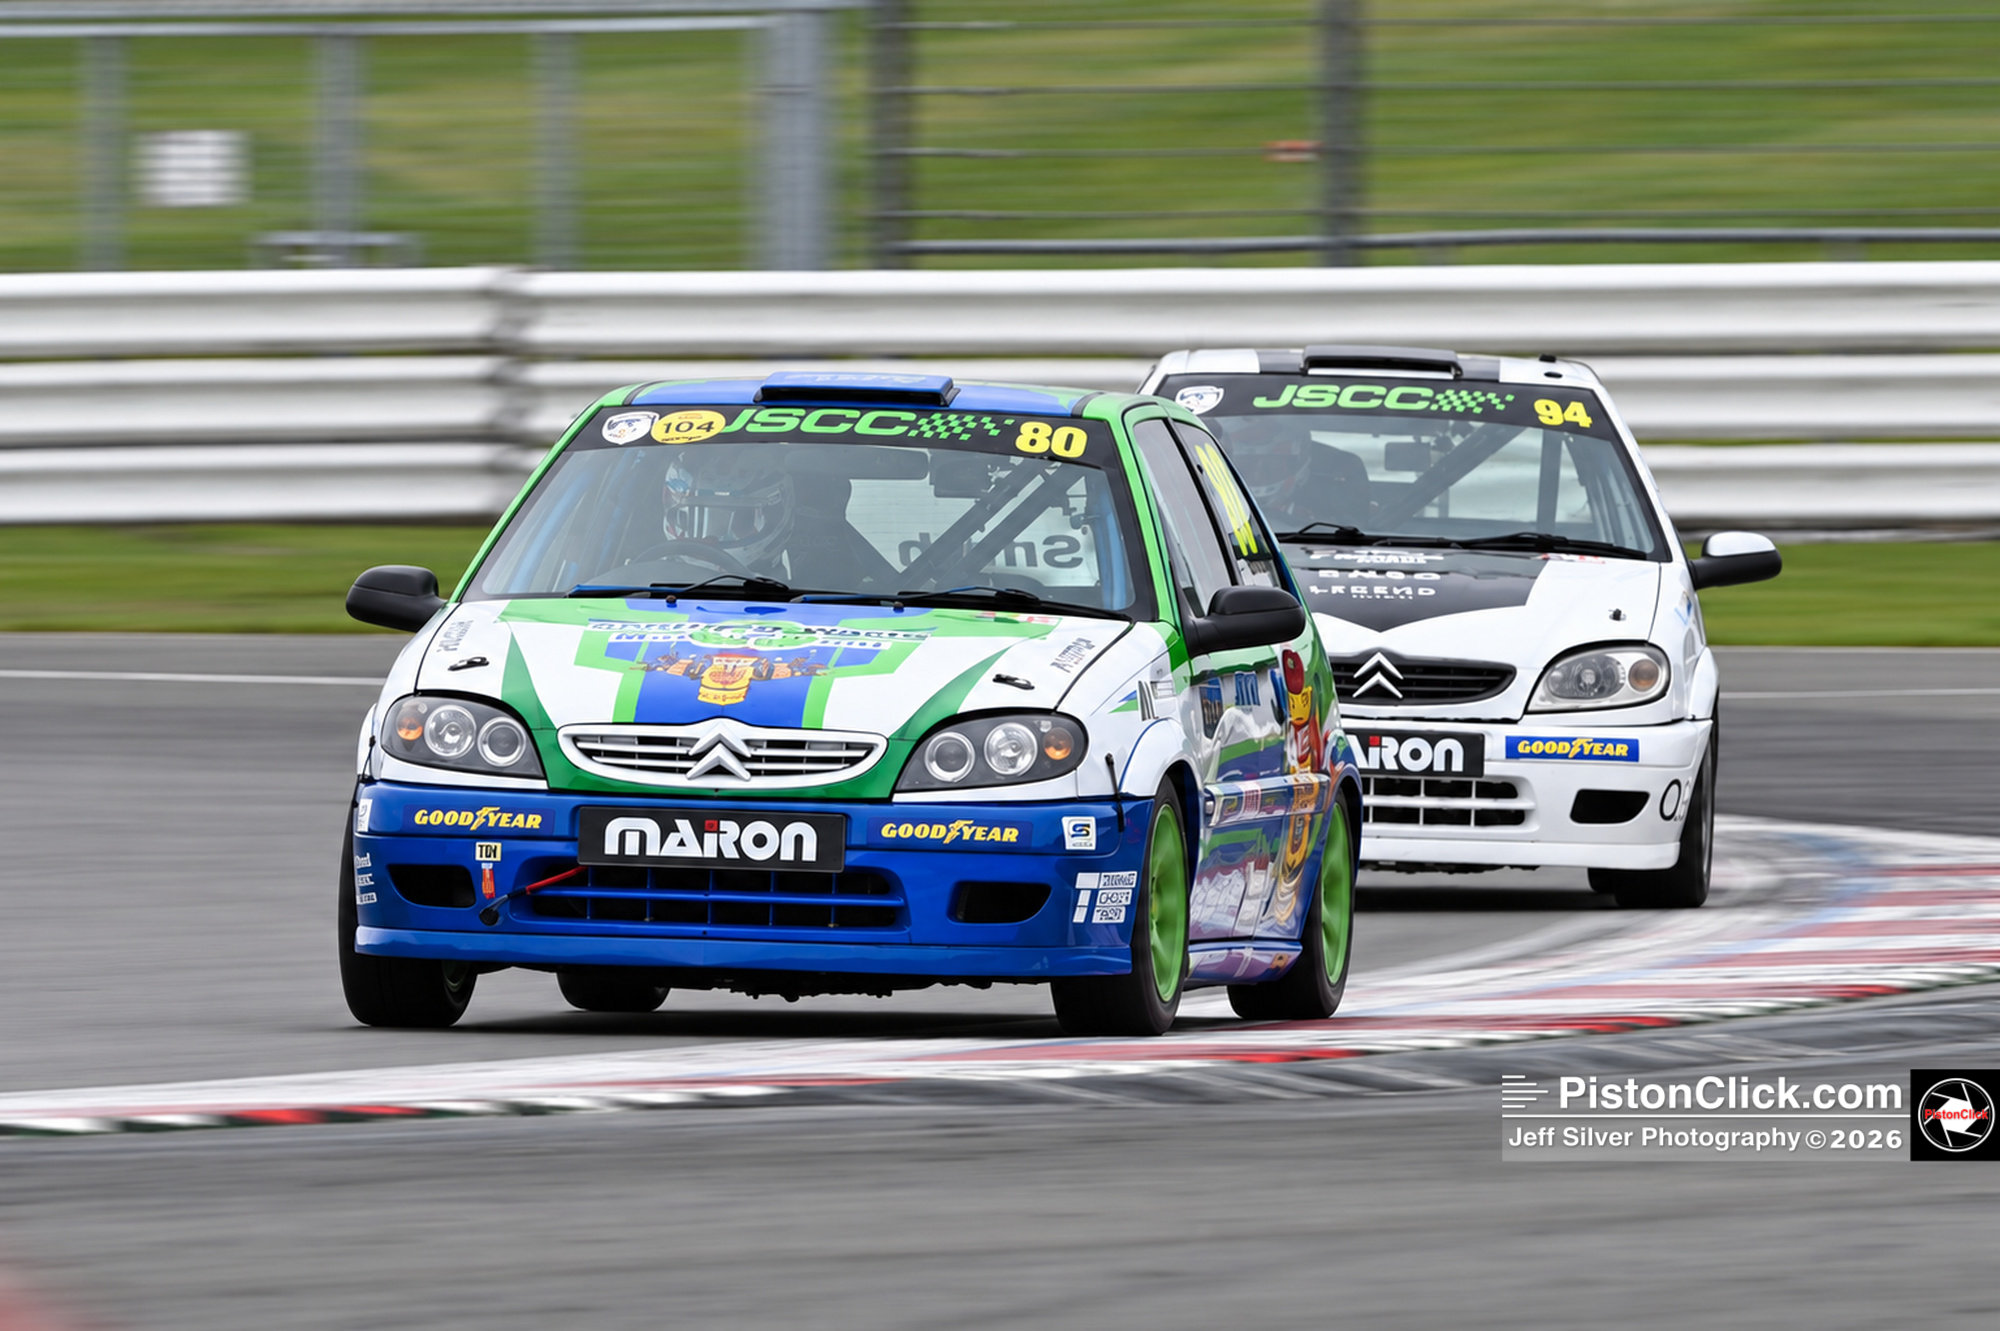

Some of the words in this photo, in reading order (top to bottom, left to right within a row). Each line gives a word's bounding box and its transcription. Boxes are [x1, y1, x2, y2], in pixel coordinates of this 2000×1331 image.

[1253, 384, 1434, 411] JSCC
[722, 407, 918, 436] JSCC
[1533, 398, 1593, 429] 94
[663, 420, 715, 434] 104
[1014, 421, 1088, 459] 80
[1517, 738, 1628, 758] GOODYEAR
[414, 807, 542, 831] GOODYEAR
[881, 820, 1019, 844] GOODYEAR
